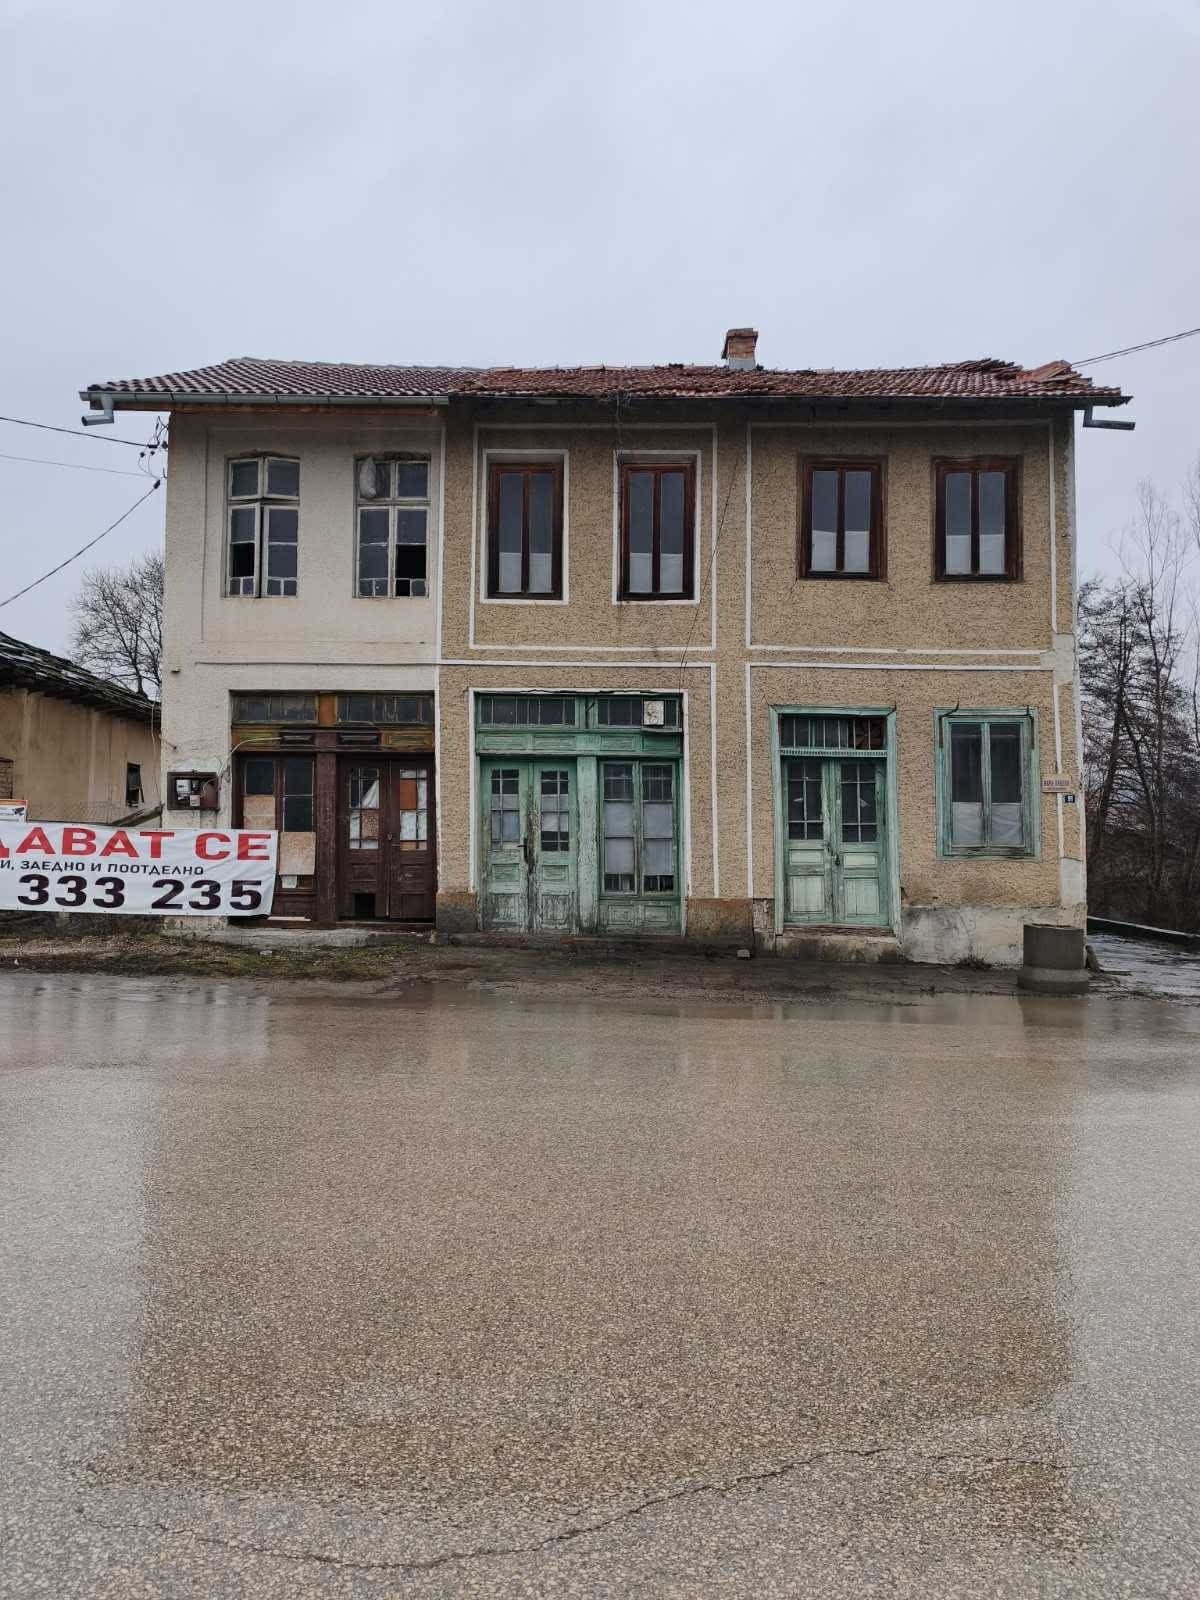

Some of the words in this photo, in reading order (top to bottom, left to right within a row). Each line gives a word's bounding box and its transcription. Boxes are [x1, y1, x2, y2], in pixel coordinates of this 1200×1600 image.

[0, 827, 175, 858] АВАТ
[195, 833, 272, 861] СЕ
[20, 860, 85, 873] ЗАЕДНО
[90, 862, 102, 873] И
[107, 863, 204, 876] ПООТДЕЛНО
[17, 873, 126, 909] 333
[151, 878, 262, 911] 235
